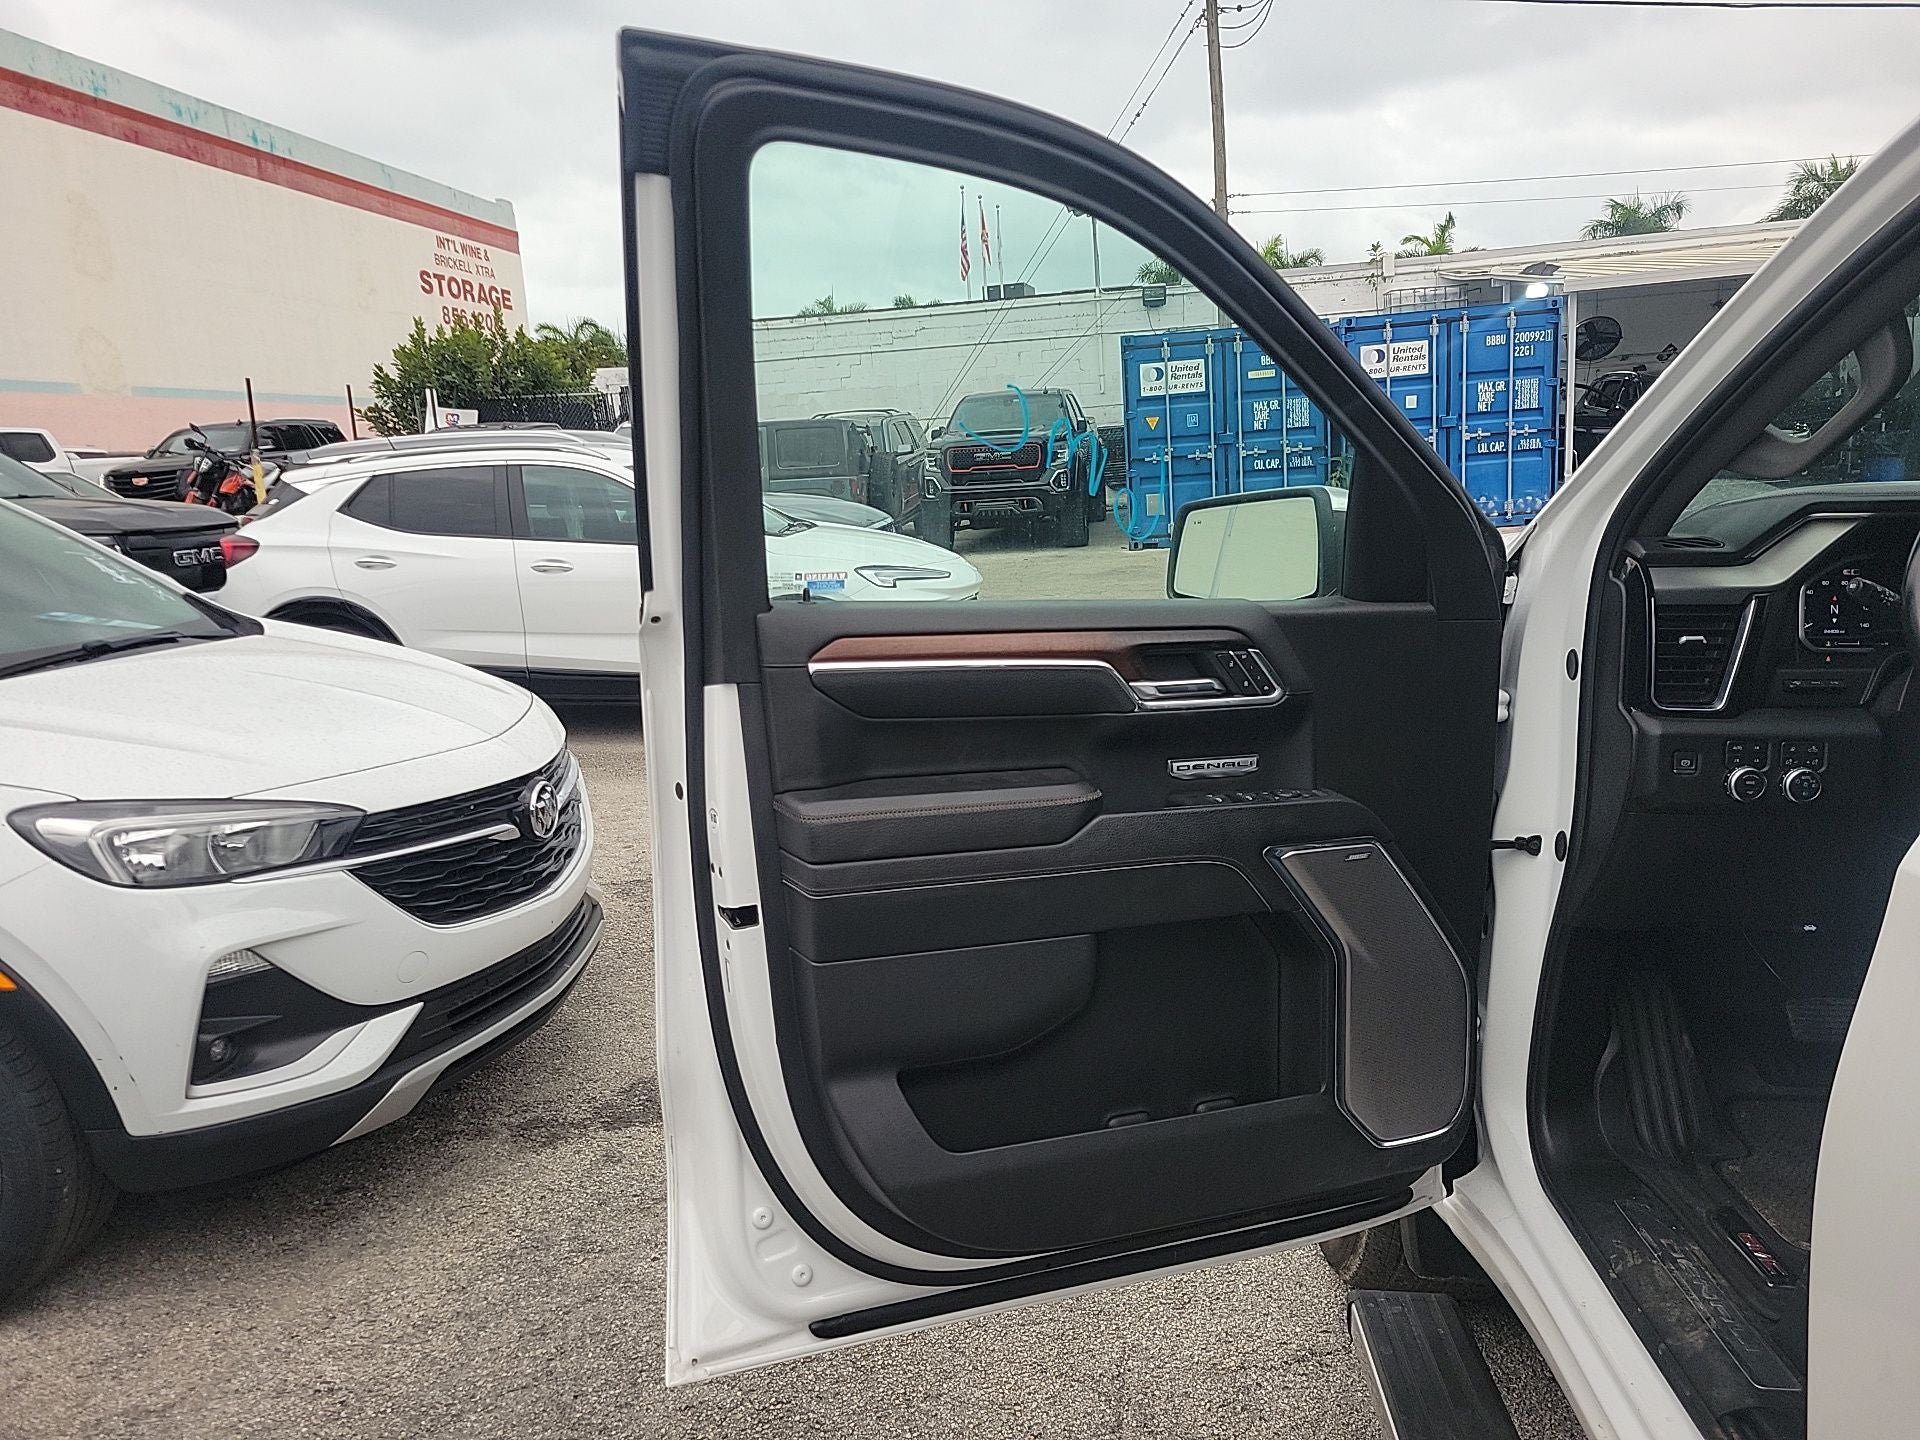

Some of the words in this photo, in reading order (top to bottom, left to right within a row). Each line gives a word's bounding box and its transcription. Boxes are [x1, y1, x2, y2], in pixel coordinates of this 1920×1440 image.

[436, 234, 459, 254] INT'L
[459, 242, 482, 260] WINE
[483, 249, 490, 262] &
[434, 253, 473, 274] BRICKELL
[475, 264, 496, 280] XTRA
[419, 270, 513, 310] STORAGE
[1392, 344, 1424, 355] United
[1514, 345, 1534, 357] 22G1
[1392, 353, 1427, 363] Rentals
[1170, 363, 1200, 373] United
[1170, 371, 1203, 381] Rentals
[1478, 391, 1495, 402] TARE
[1477, 401, 1492, 412] NET
[1254, 410, 1270, 421] TARE
[1253, 420, 1267, 431] NET
[973, 451, 1012, 461] GMC
[172, 546, 225, 567] GMC
[1830, 604, 1839, 615] N
[1176, 760, 1254, 772] DENALI
